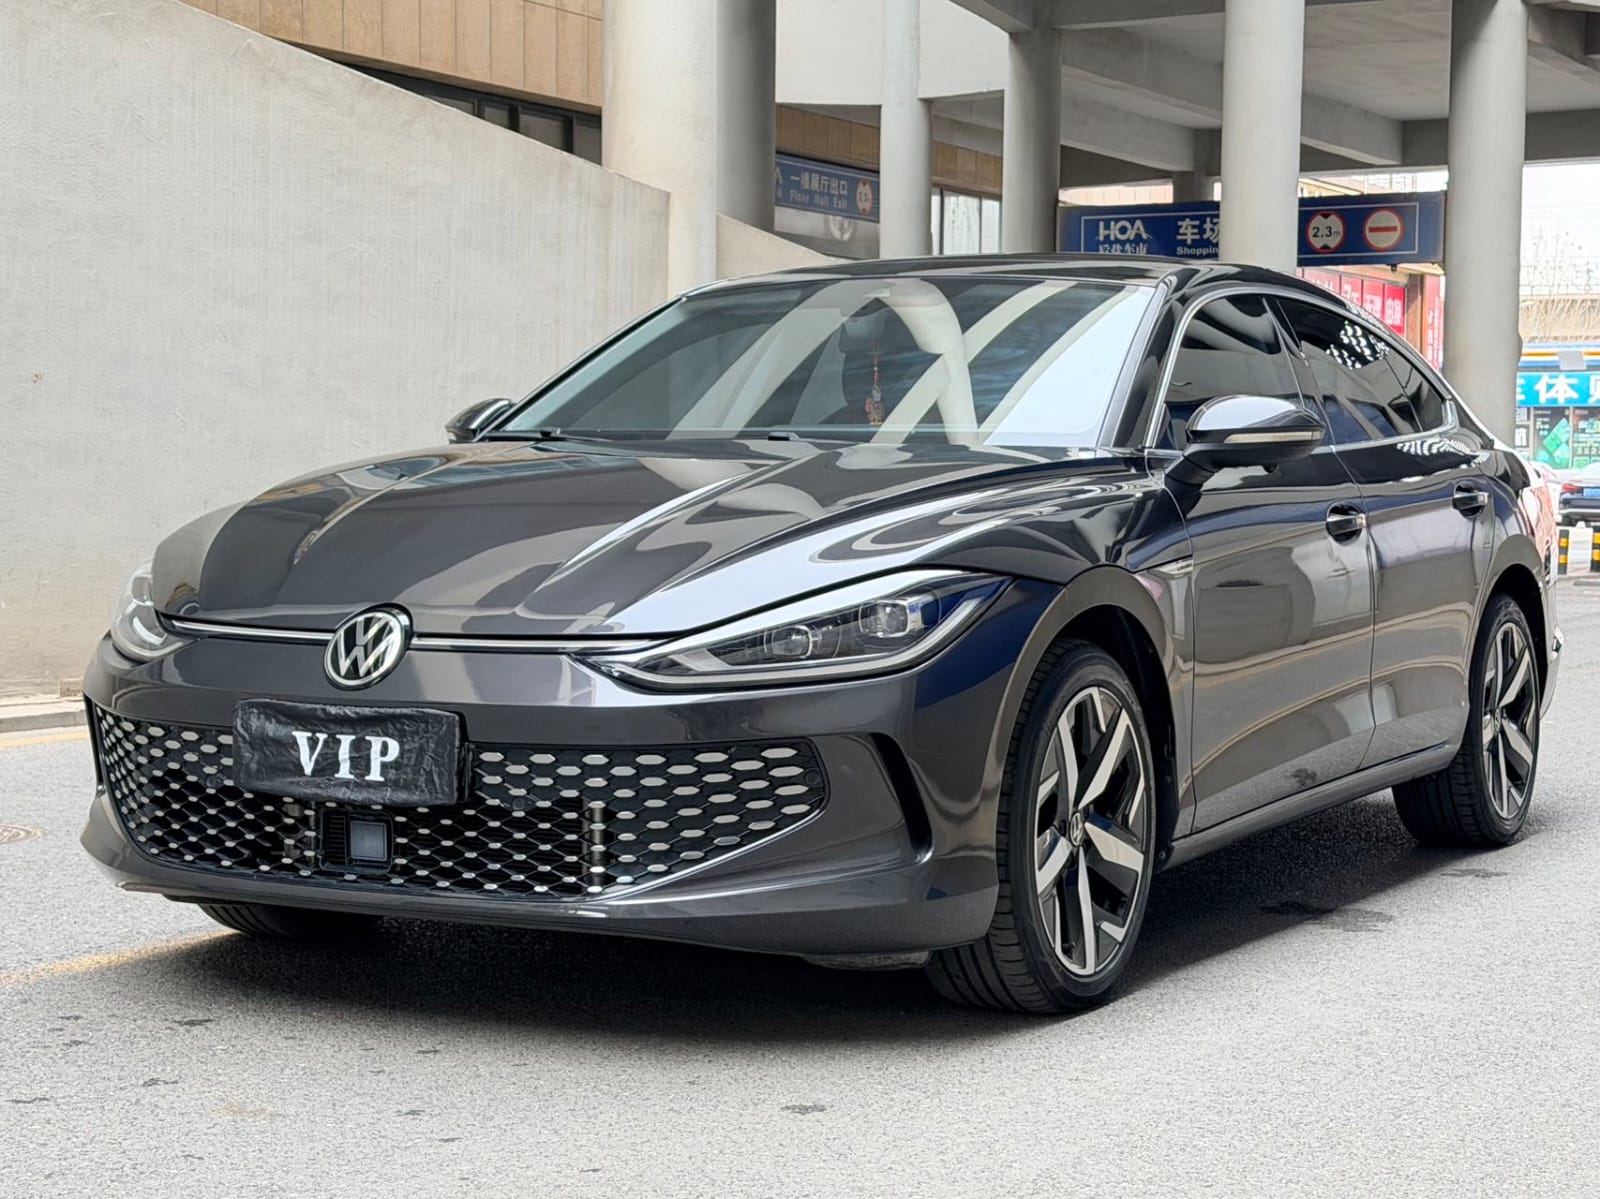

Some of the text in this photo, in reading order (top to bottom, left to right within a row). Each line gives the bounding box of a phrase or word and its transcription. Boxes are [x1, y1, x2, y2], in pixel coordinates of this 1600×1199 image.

[1098, 219, 1149, 241] HOA
[1176, 246, 1219, 256] Shoppin
[291, 731, 400, 782] VIP
